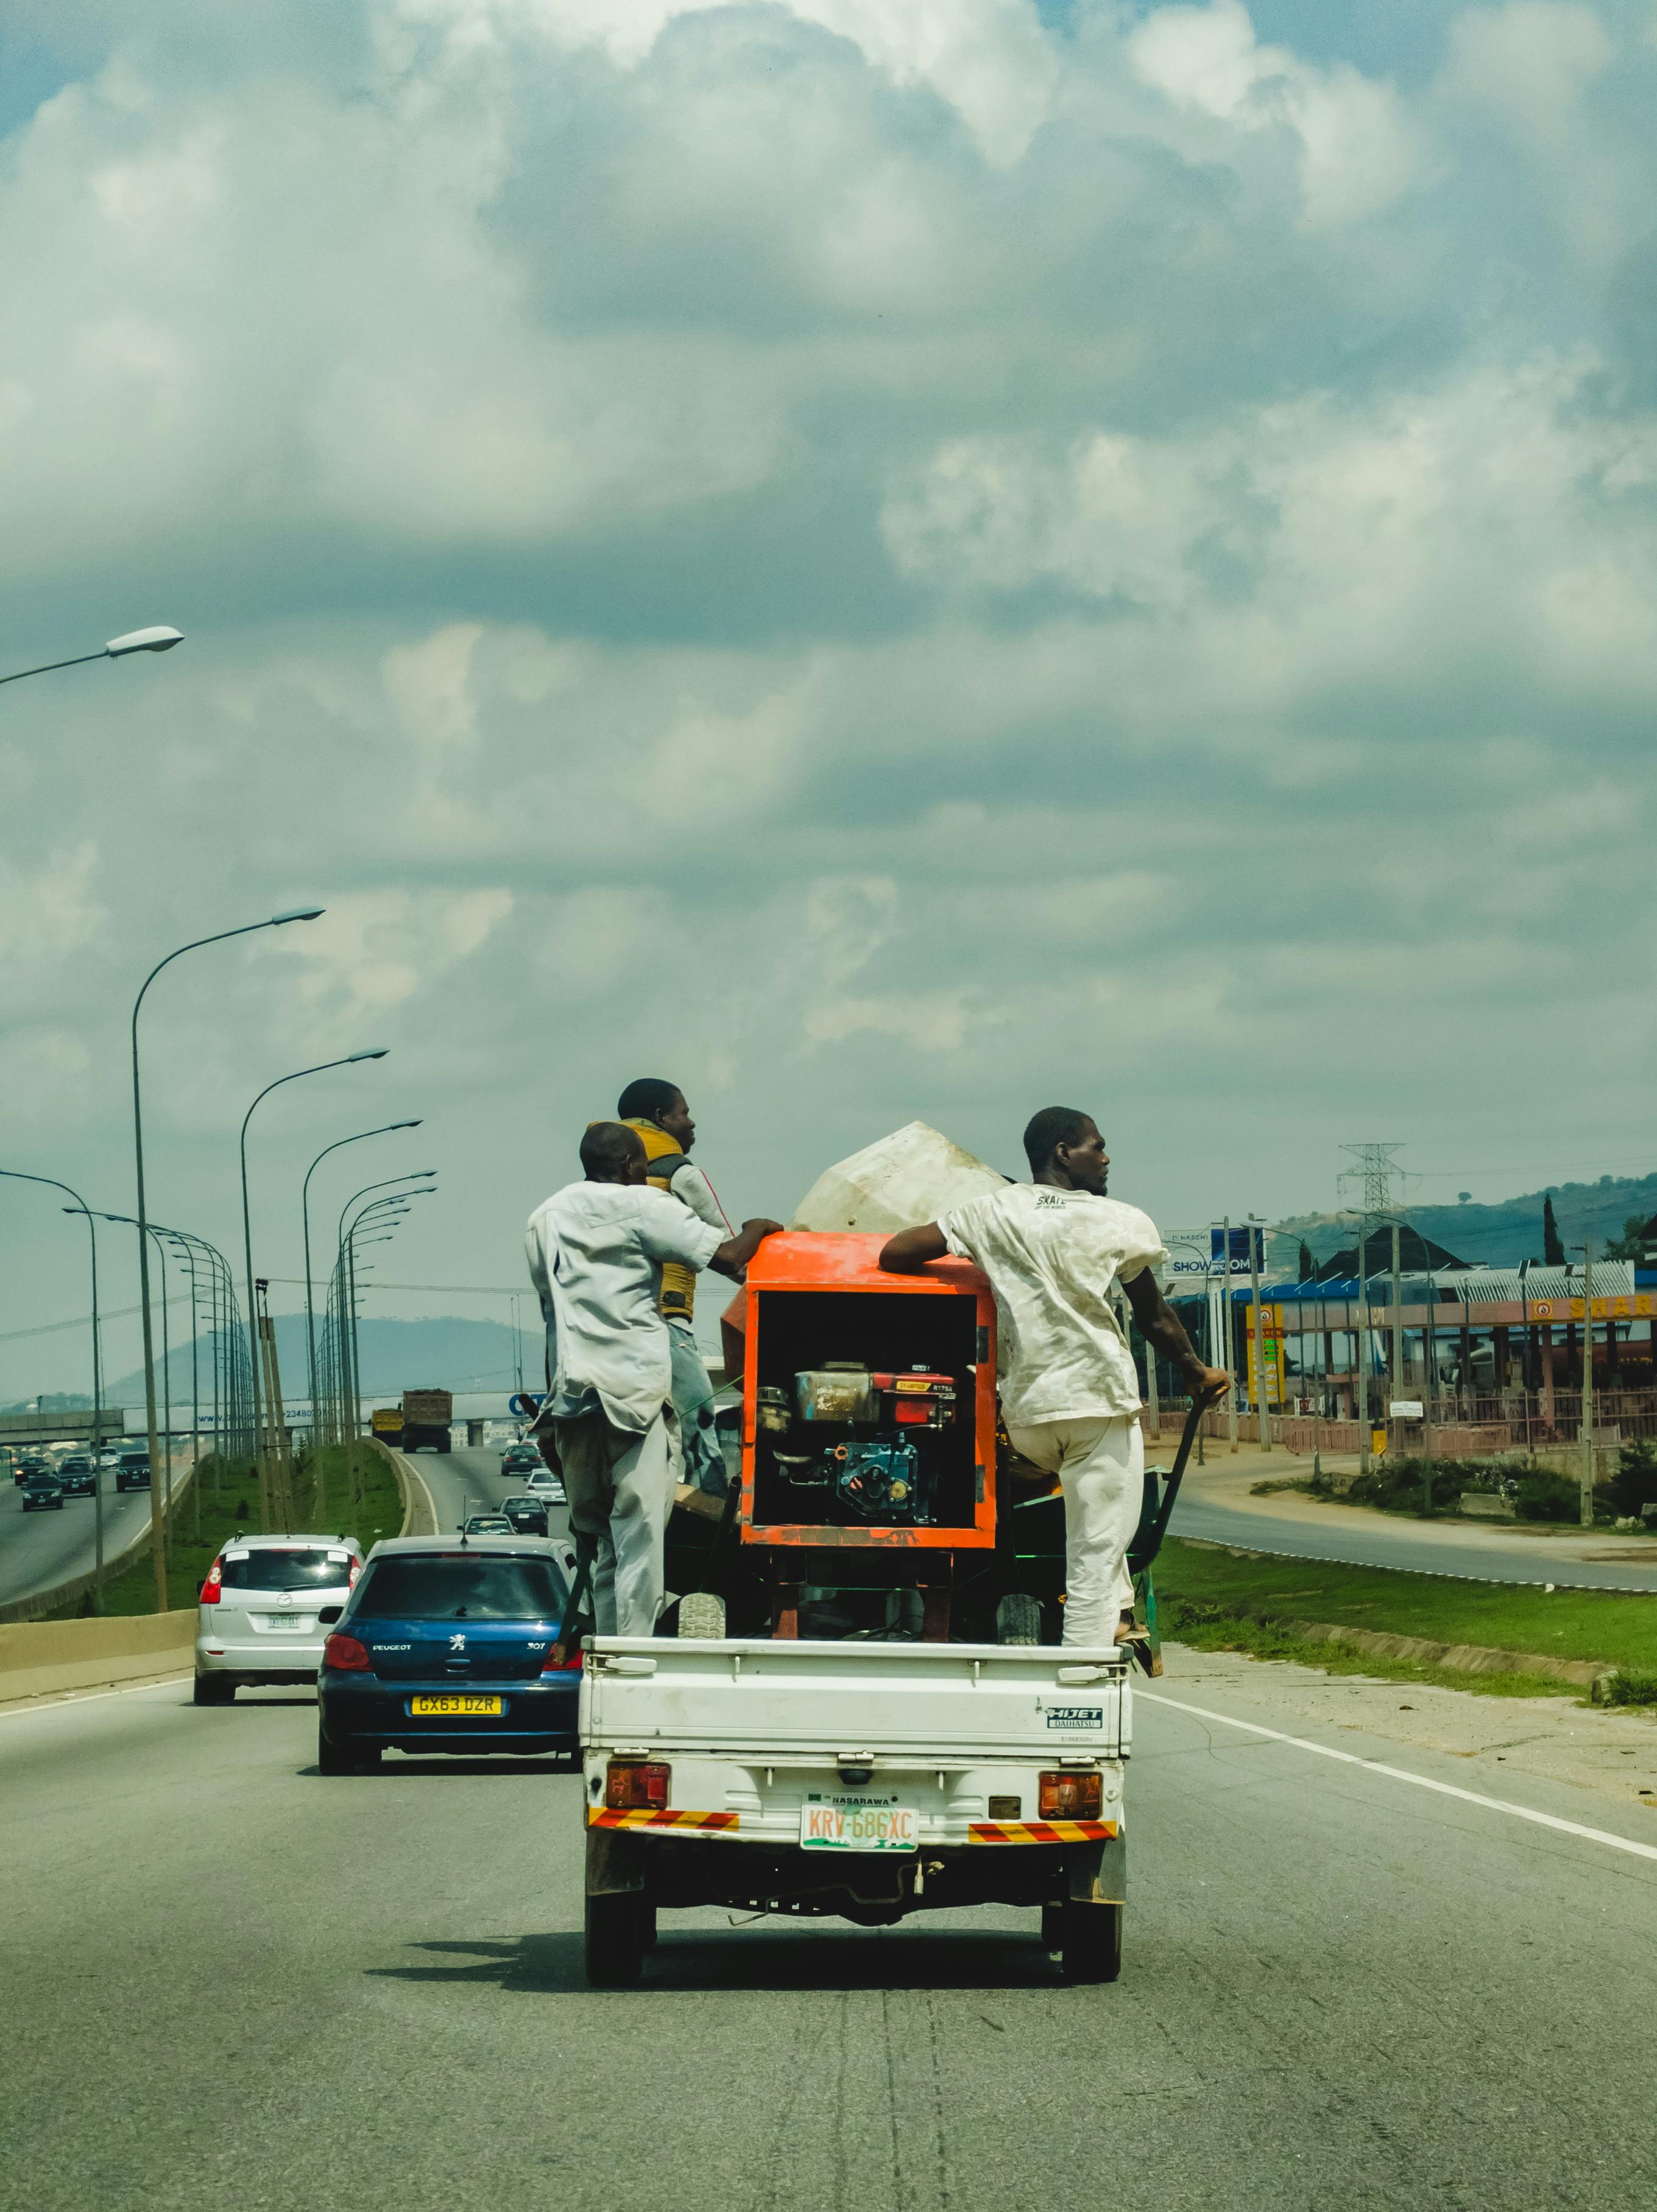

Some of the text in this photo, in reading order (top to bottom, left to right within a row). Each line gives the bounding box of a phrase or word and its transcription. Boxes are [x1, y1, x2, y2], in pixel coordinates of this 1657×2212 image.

[1570, 1295, 1657, 1318] SHAR
[420, 1697, 493, 1711] GX63 DZR
[1048, 1709, 1101, 1719] HIJET
[832, 1797, 889, 1806] NASARAWA
[810, 1809, 913, 1839] KRV-686XC
